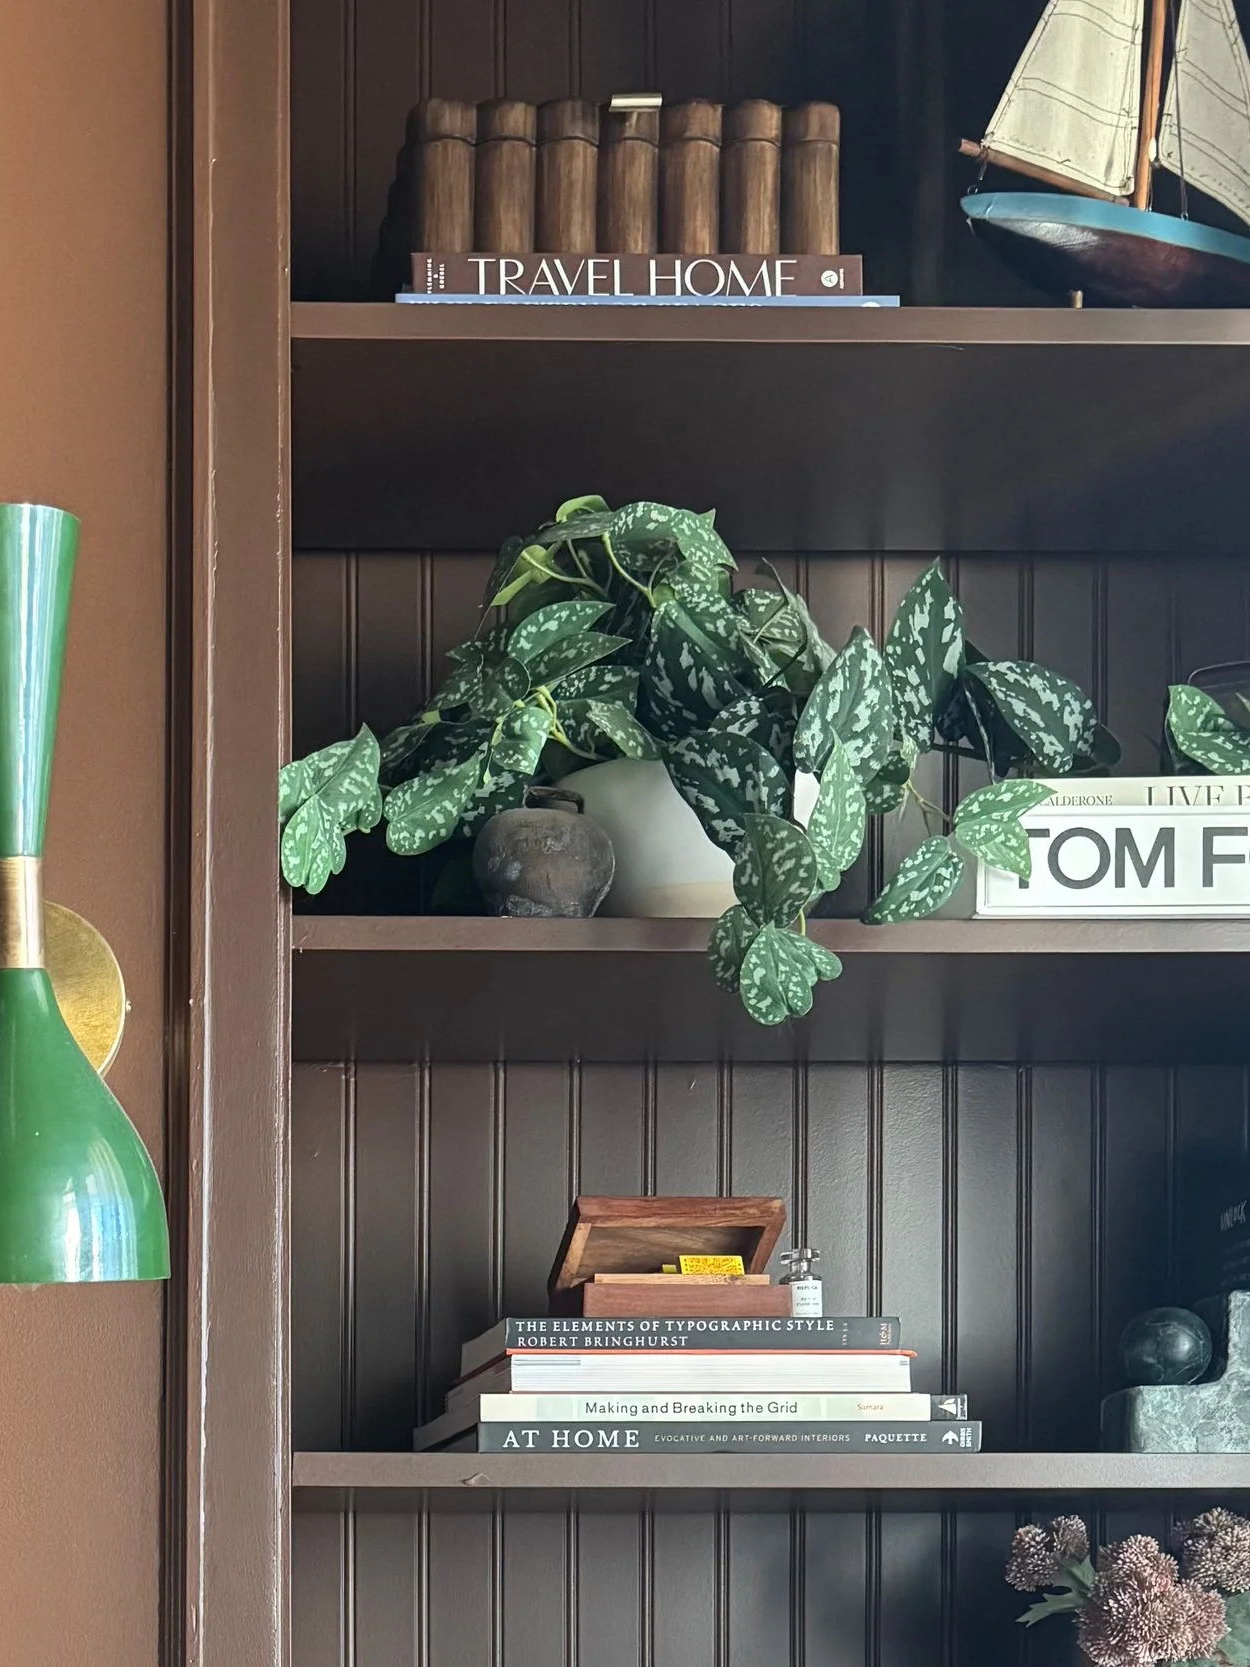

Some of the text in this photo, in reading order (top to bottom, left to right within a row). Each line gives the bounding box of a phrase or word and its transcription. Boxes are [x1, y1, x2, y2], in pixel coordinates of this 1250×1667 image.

[467, 258, 635, 296] TRAVEL
[649, 258, 798, 297] HOME
[1018, 826, 1250, 890] OM F
[515, 1319, 835, 1332] THE ELEMENTS OF TYPOGRAPHIC STYLE
[517, 1336, 689, 1347] ROBERT BRINGHURST
[585, 1401, 798, 1416] Making and Breaking the Grid
[502, 1429, 928, 1448] AT HOME EVOCATIVE AND ART-FORWARD INTERIORS PAQUETTE
